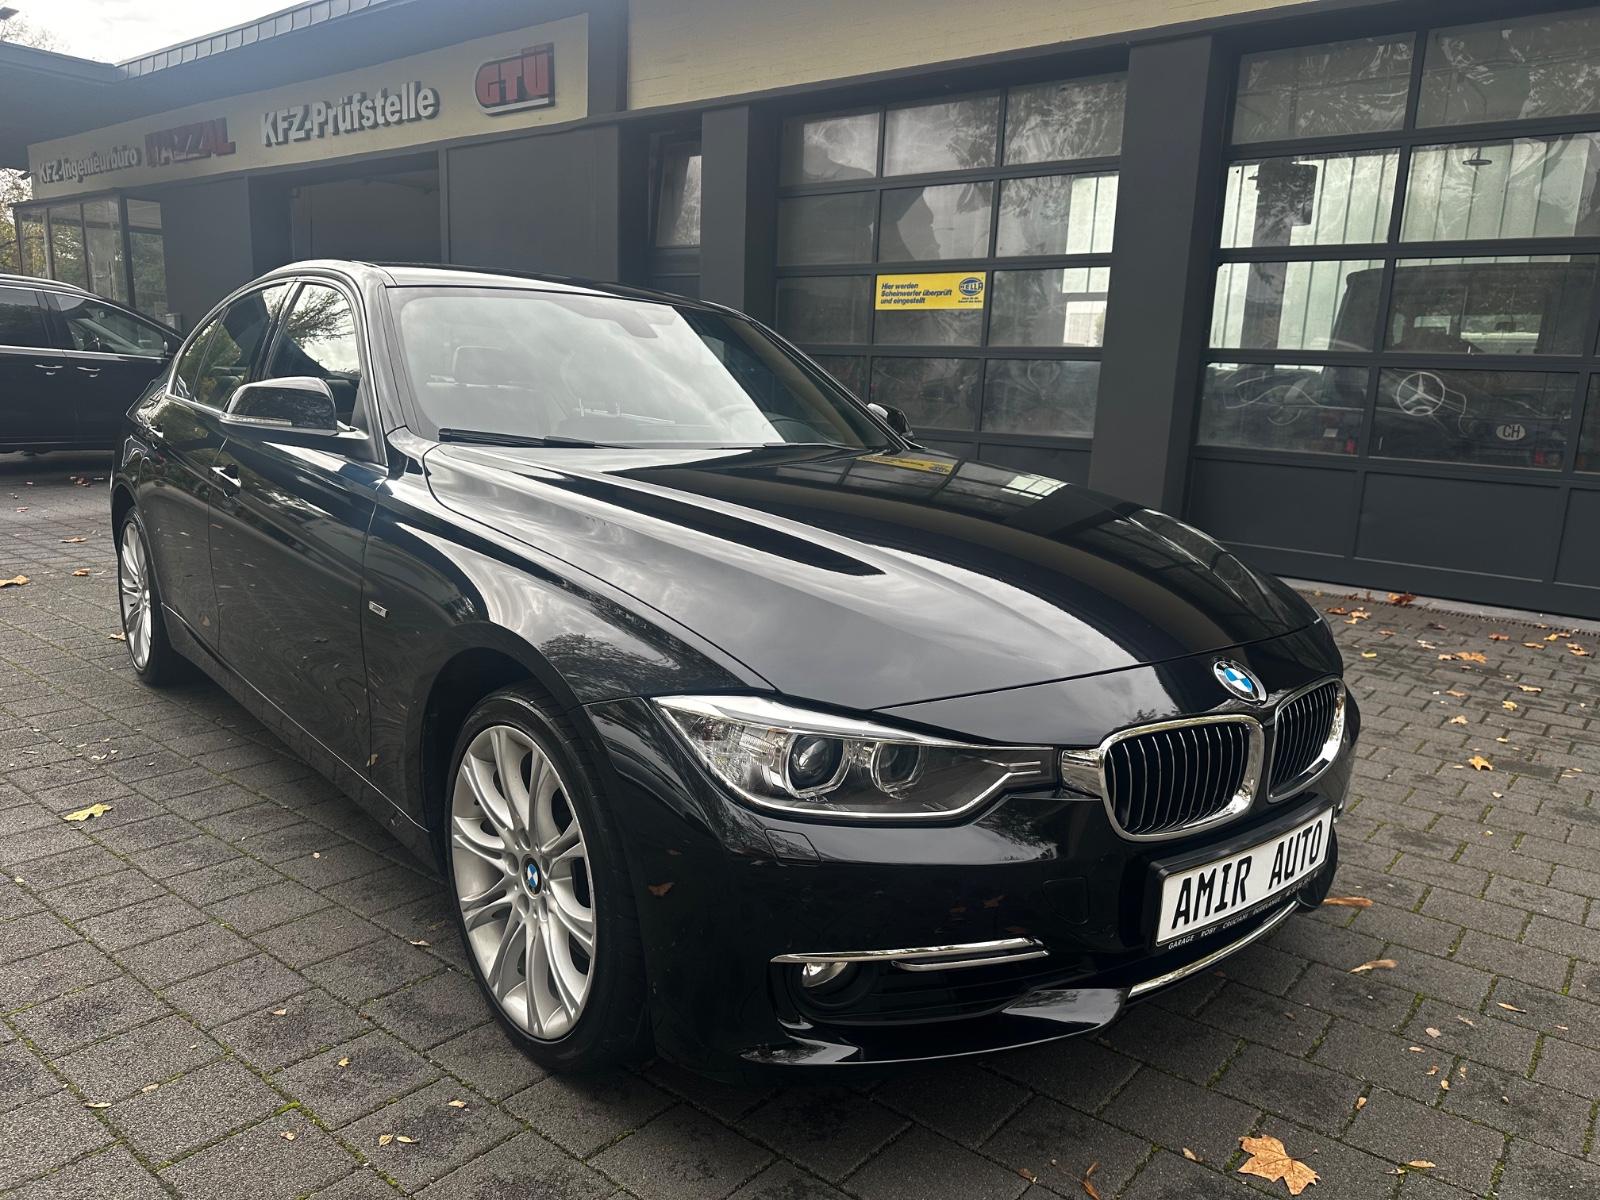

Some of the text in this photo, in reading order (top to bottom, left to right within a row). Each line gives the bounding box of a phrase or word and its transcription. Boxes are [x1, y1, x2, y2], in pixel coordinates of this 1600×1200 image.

[476, 44, 551, 106] GTÜ
[261, 80, 438, 147] KFZ-Prüfstelle
[39, 144, 141, 184] KFZ-Ingenieurbüro
[881, 282, 919, 290] Hier werden
[922, 288, 953, 297] überprüft
[893, 297, 926, 305] eingestellt
[1503, 424, 1521, 439] CH
[1171, 819, 1324, 930] AMIR AUTO
[1168, 934, 1196, 950] GARAGE
